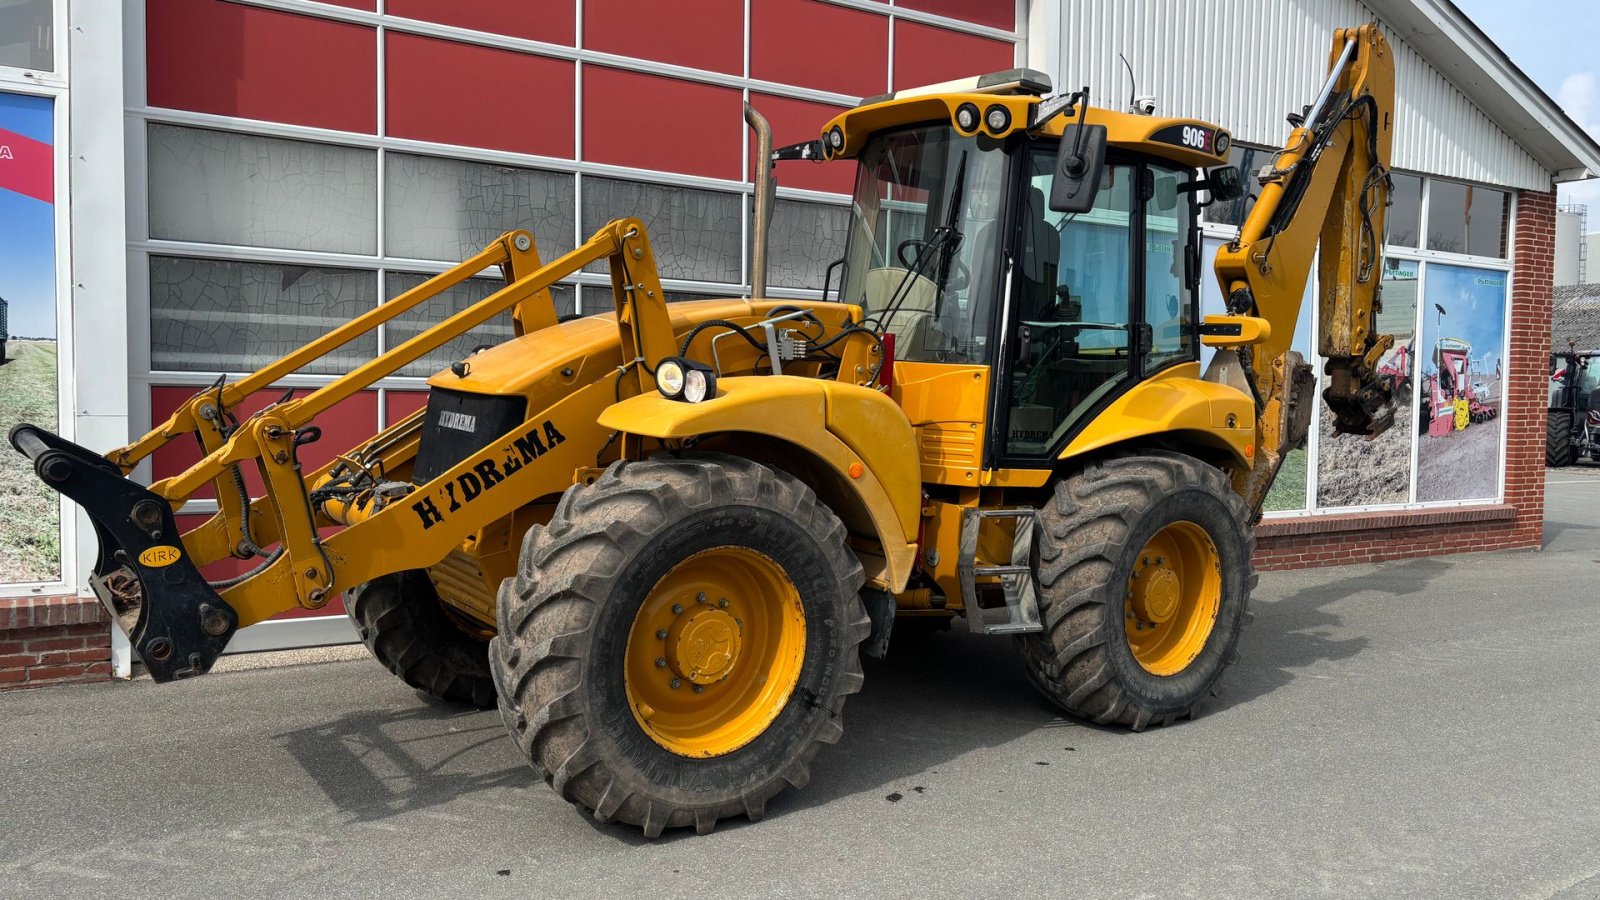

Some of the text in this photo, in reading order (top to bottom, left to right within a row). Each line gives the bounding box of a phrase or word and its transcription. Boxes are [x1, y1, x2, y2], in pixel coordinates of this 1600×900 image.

[1182, 126, 1212, 151] 906E
[438, 410, 476, 433] HYDREMA
[1012, 429, 1054, 439] HYDREMA
[143, 550, 177, 563] KIRK
